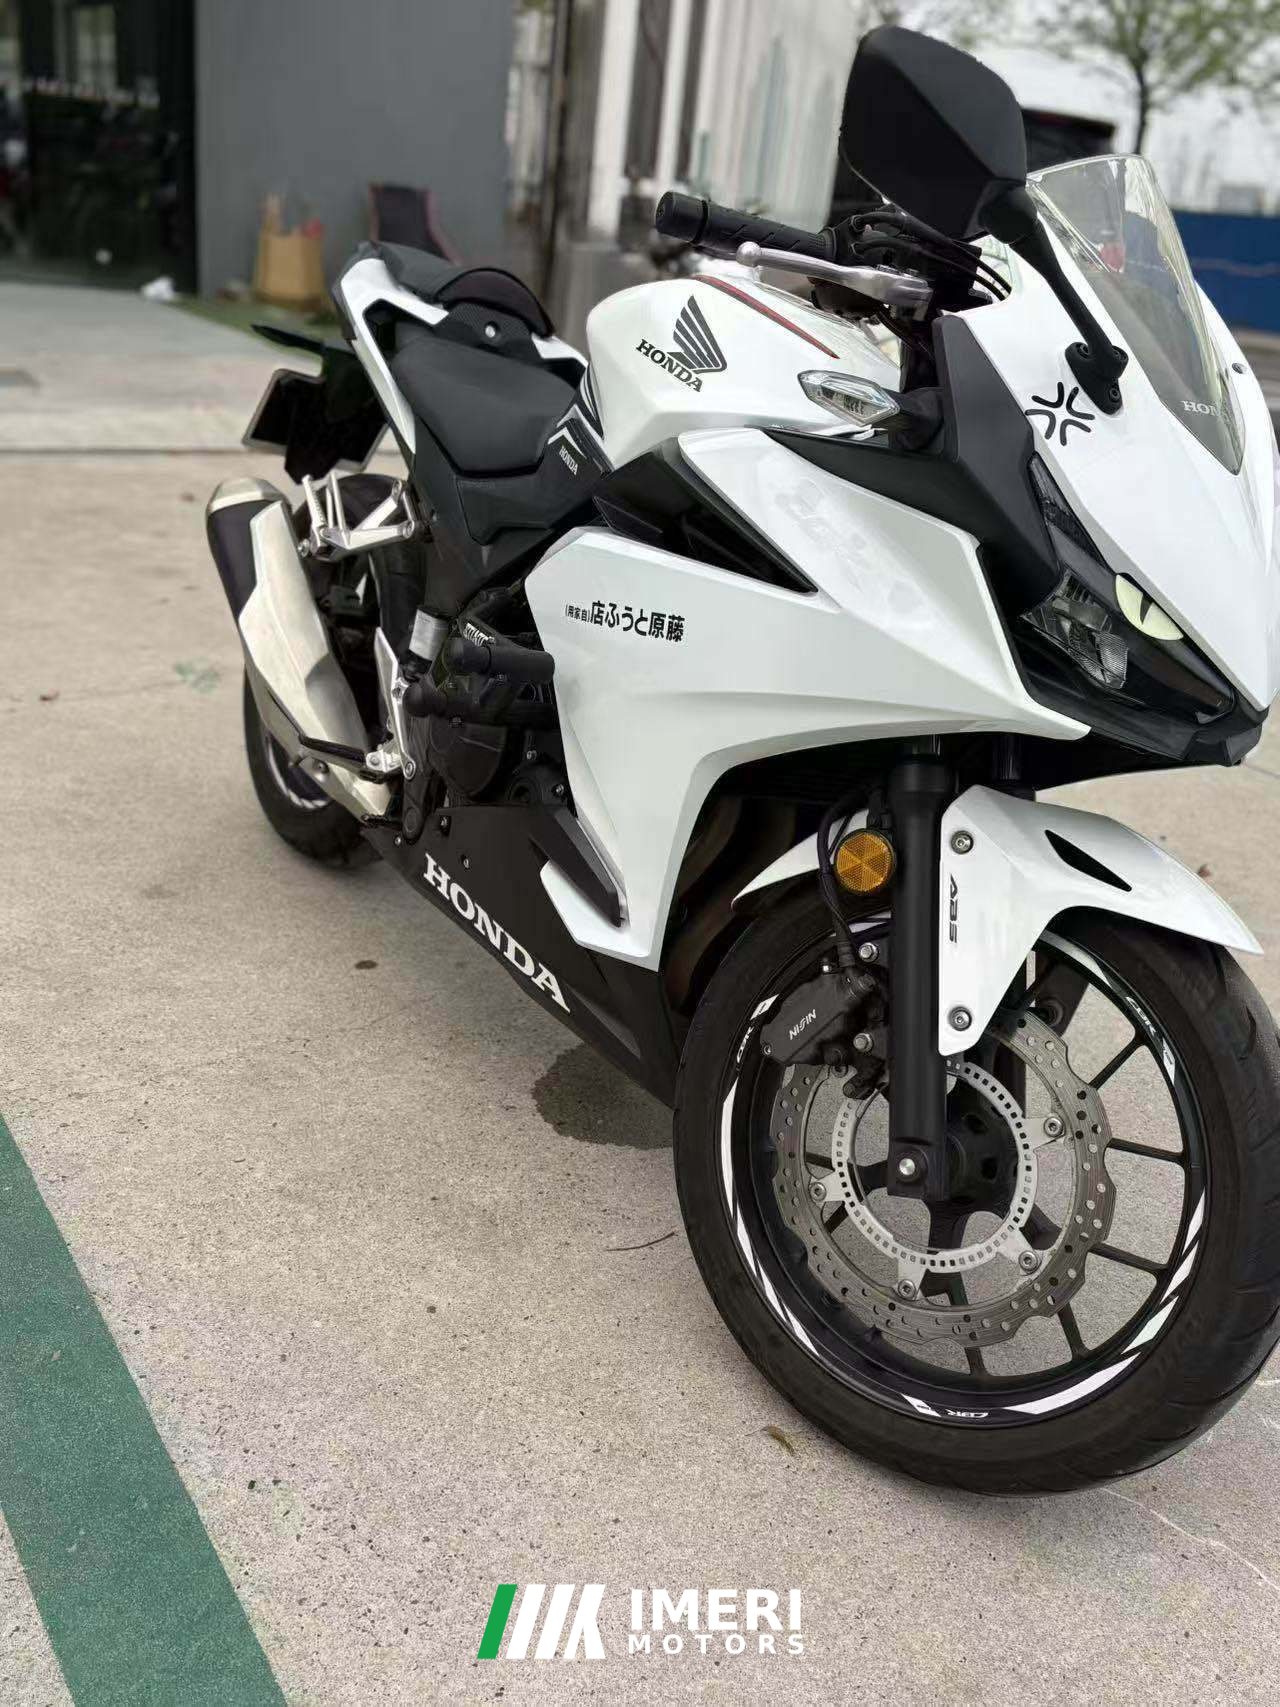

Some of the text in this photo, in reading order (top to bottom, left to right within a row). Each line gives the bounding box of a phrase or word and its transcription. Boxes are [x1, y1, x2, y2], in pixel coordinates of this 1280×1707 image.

[636, 339, 703, 392] HONDA
[1181, 400, 1224, 418] HON
[559, 445, 578, 476] HONDA
[423, 852, 571, 1013] HONDA
[949, 873, 958, 943] ABS
